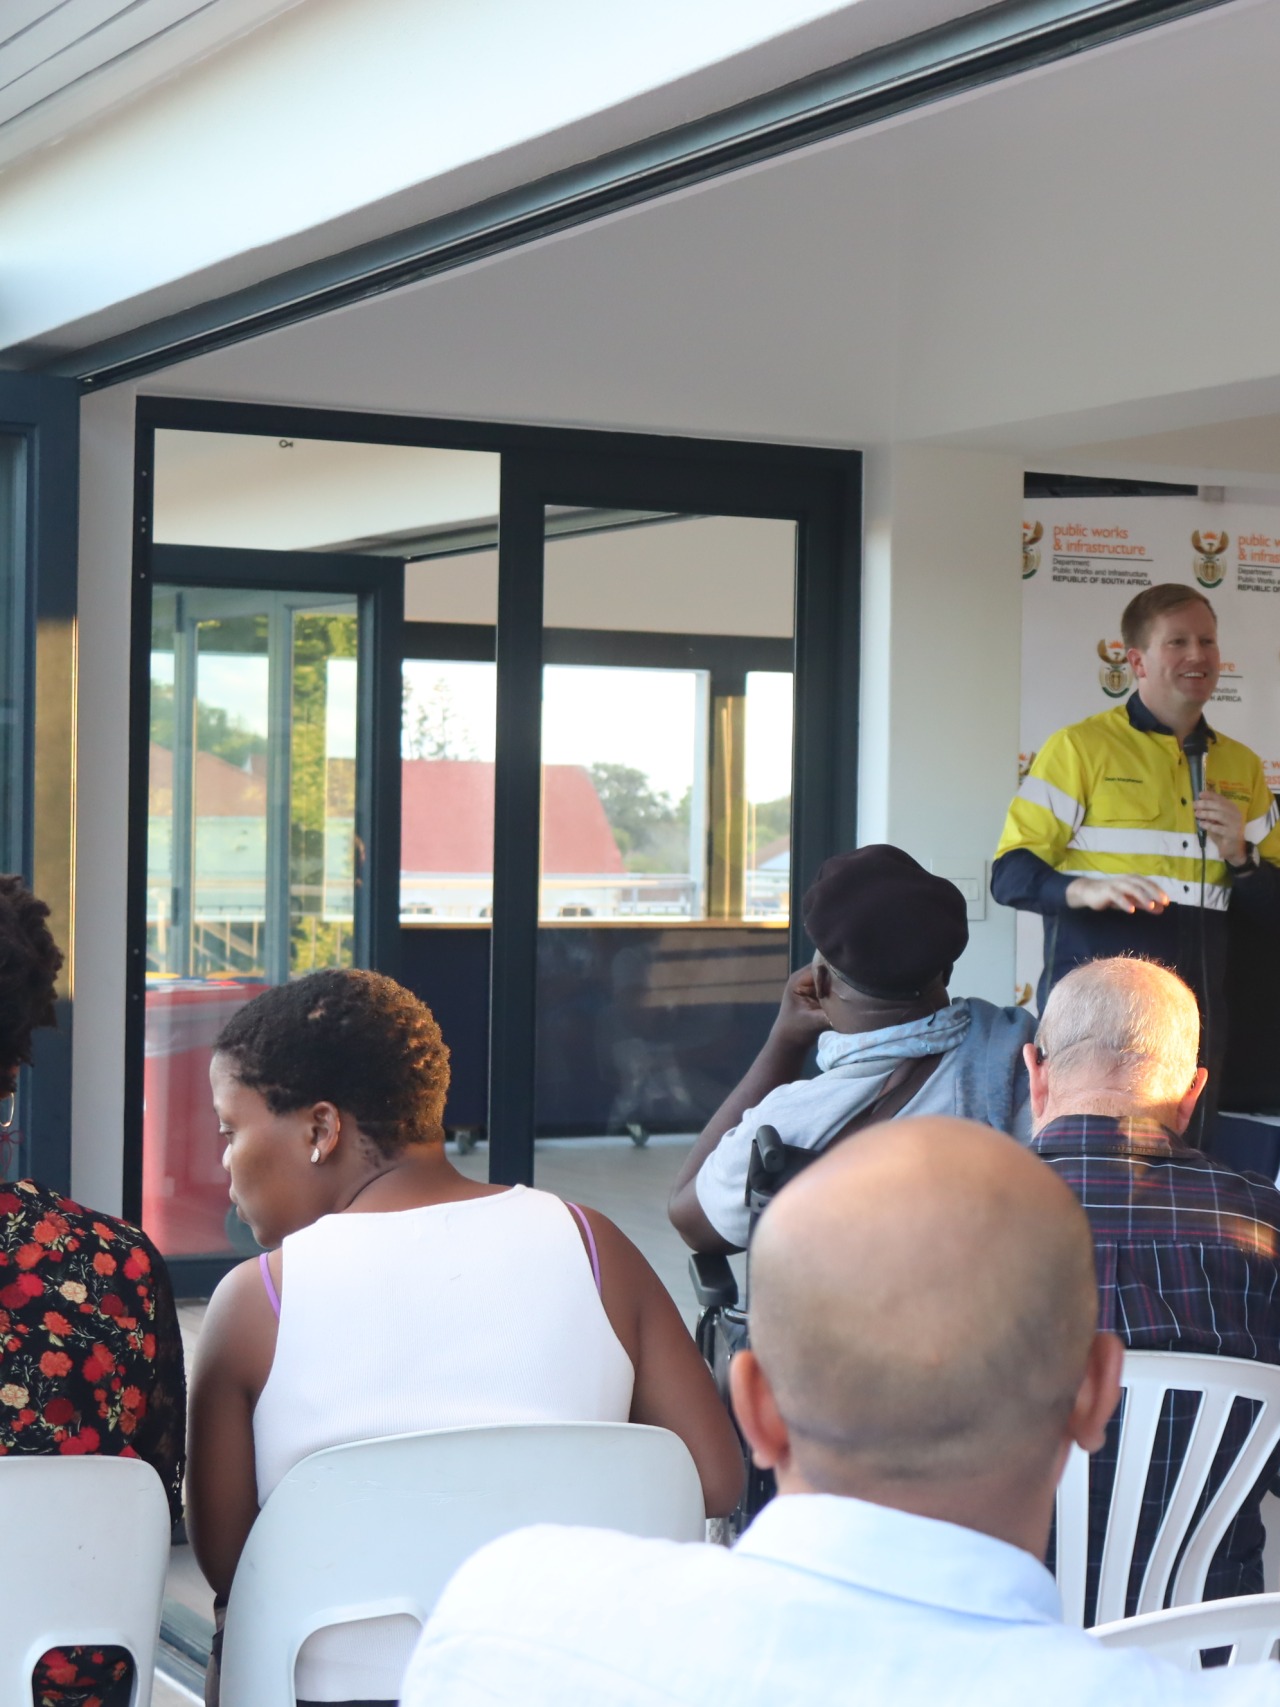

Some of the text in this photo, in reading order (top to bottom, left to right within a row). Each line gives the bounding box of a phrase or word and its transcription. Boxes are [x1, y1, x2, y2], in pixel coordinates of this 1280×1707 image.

[1054, 524, 1128, 540] public works
[1066, 540, 1145, 554] infrastructure
[1238, 534, 1271, 550] public
[1101, 577, 1125, 585] SOUTH
[1126, 578, 1152, 586] AFRICA
